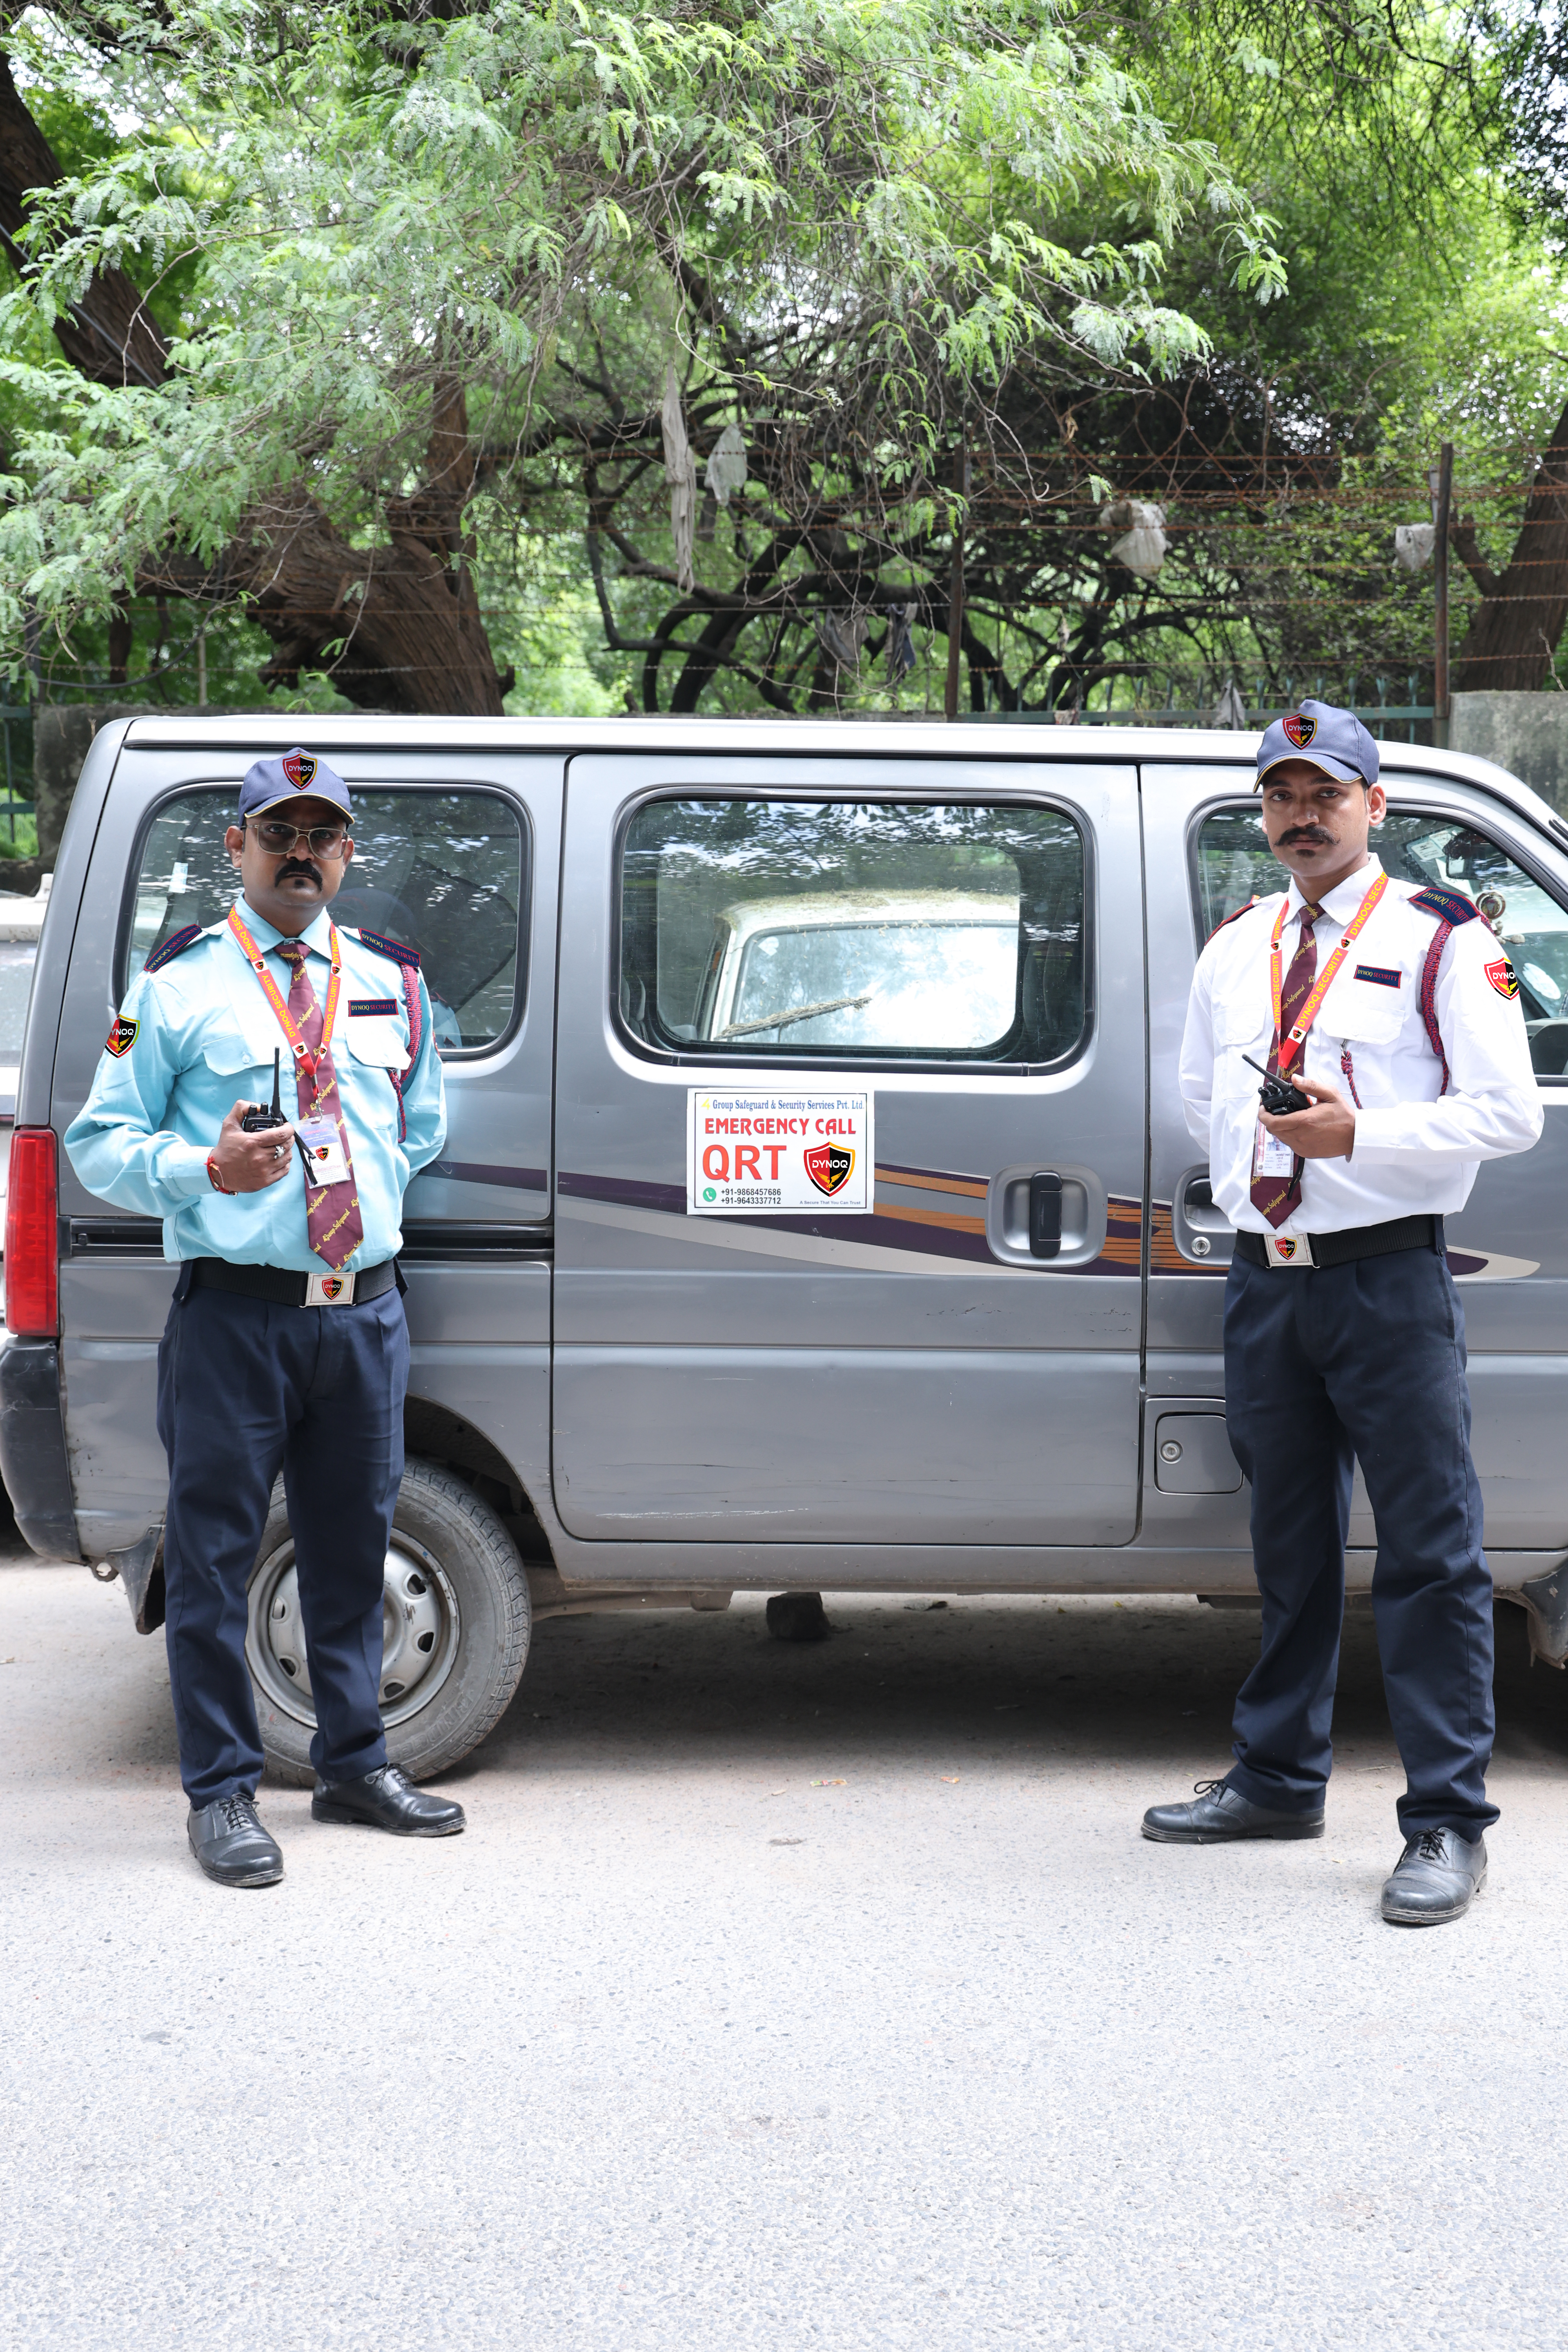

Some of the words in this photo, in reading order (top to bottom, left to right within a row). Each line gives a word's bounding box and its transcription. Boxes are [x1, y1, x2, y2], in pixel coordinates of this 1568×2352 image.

[229, 908, 243, 931] SECU
[1350, 903, 1373, 936] DYNOQ
[1422, 892, 1449, 906] DYNOQ
[1446, 900, 1470, 922] SECURITY
[149, 949, 172, 969] DYNOQ
[169, 926, 199, 948] SECURITY
[240, 931, 258, 960] DYNOQ
[362, 933, 383, 949] DYNOQ
[384, 944, 419, 963] SECURITY
[1297, 994, 1321, 1027] DYNOQ
[1316, 949, 1343, 993] SECURITY
[1373, 972, 1397, 981] SECURITY
[262, 975, 282, 1009] SECURITY
[328, 976, 338, 1012] SECURITY
[279, 1009, 296, 1038] DYNOQ
[324, 1014, 334, 1042] DYNOQ
[713, 1100, 733, 1111] Group
[735, 1100, 768, 1111] Safeguard
[771, 1100, 776, 1109] &
[778, 1100, 806, 1112] Security
[808, 1100, 834, 1109] Services
[837, 1100, 849, 1109] Pvt.
[852, 1100, 864, 1109] Ltd.
[705, 1118, 809, 1136] EMERGENCY
[815, 1118, 856, 1136] CALL
[702, 1144, 787, 1183] QRT
[812, 1160, 848, 1168] DYNOQ
[310, 1188, 328, 1209] Safeguard
[1268, 1190, 1286, 1209] Safeguard
[333, 1208, 350, 1229] Safeguard
